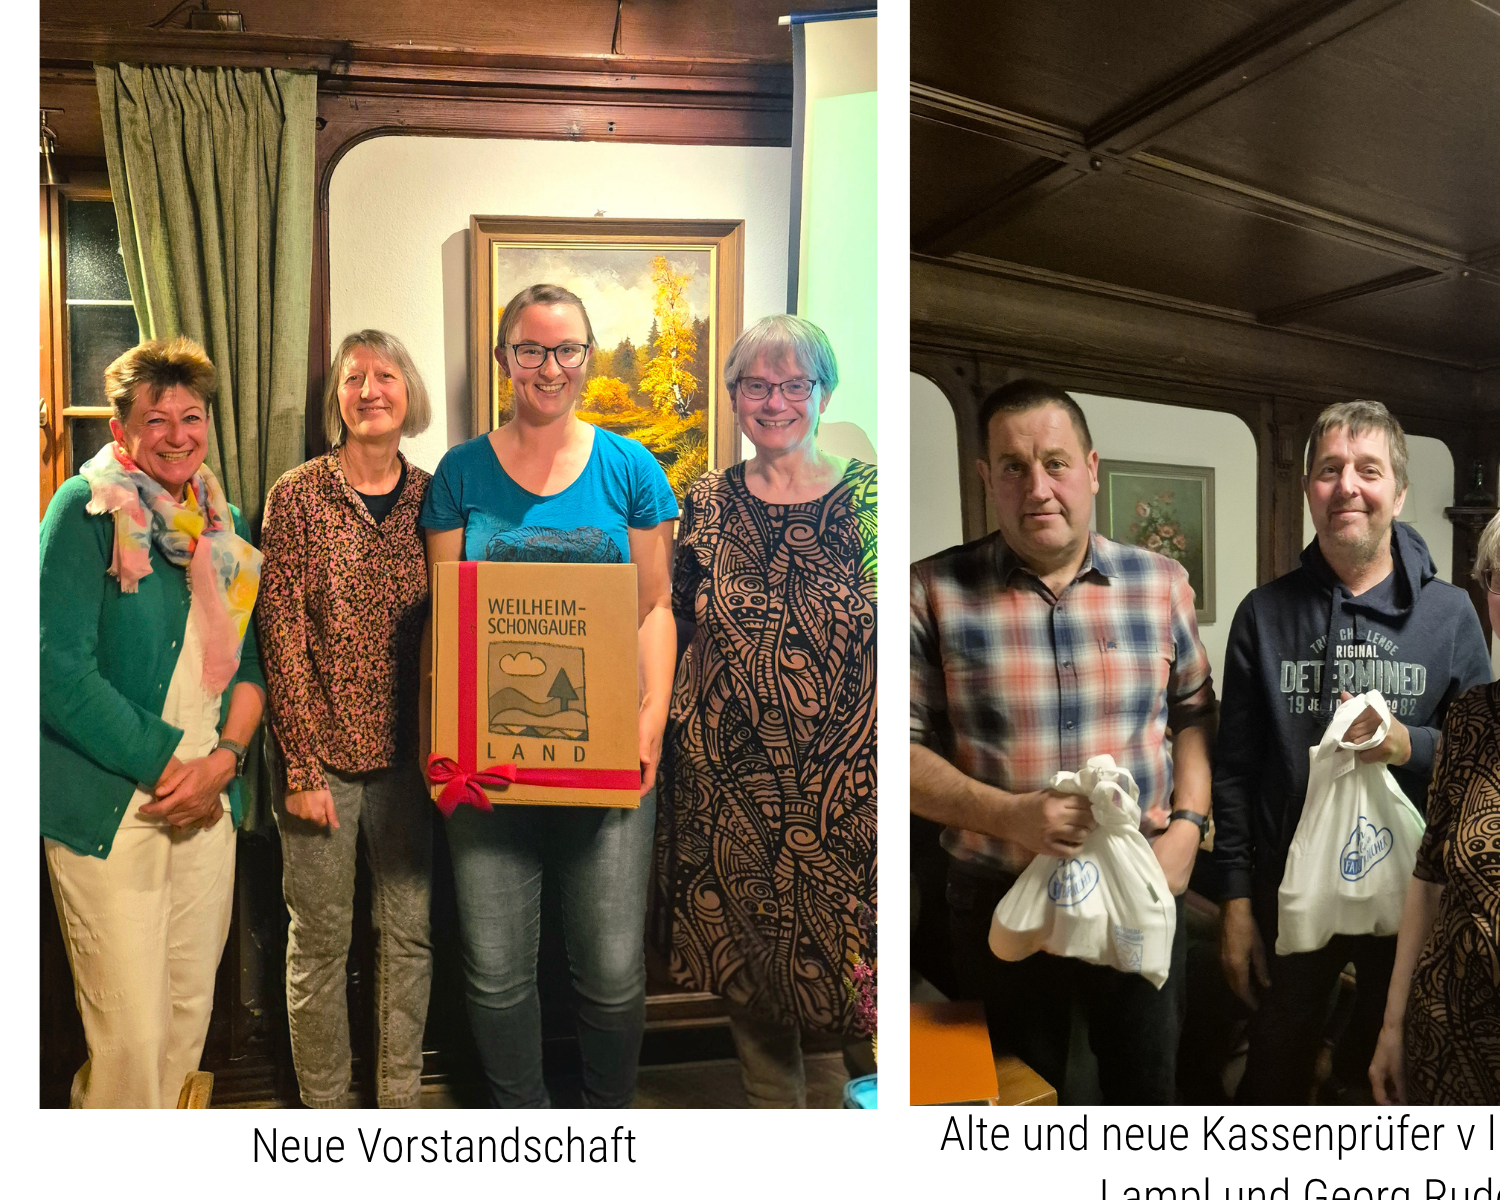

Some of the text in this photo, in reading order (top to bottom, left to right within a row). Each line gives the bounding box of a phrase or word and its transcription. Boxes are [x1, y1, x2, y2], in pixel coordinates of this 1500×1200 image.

[488, 598, 586, 616] WEILHEIM-
[487, 617, 587, 636] SCHONGAUER
[1335, 644, 1379, 658] RIGINAL
[1339, 627, 1399, 656] CHLENGE
[1287, 695, 1305, 714] 19
[1400, 698, 1417, 716] 82
[487, 742, 586, 763] LAND
